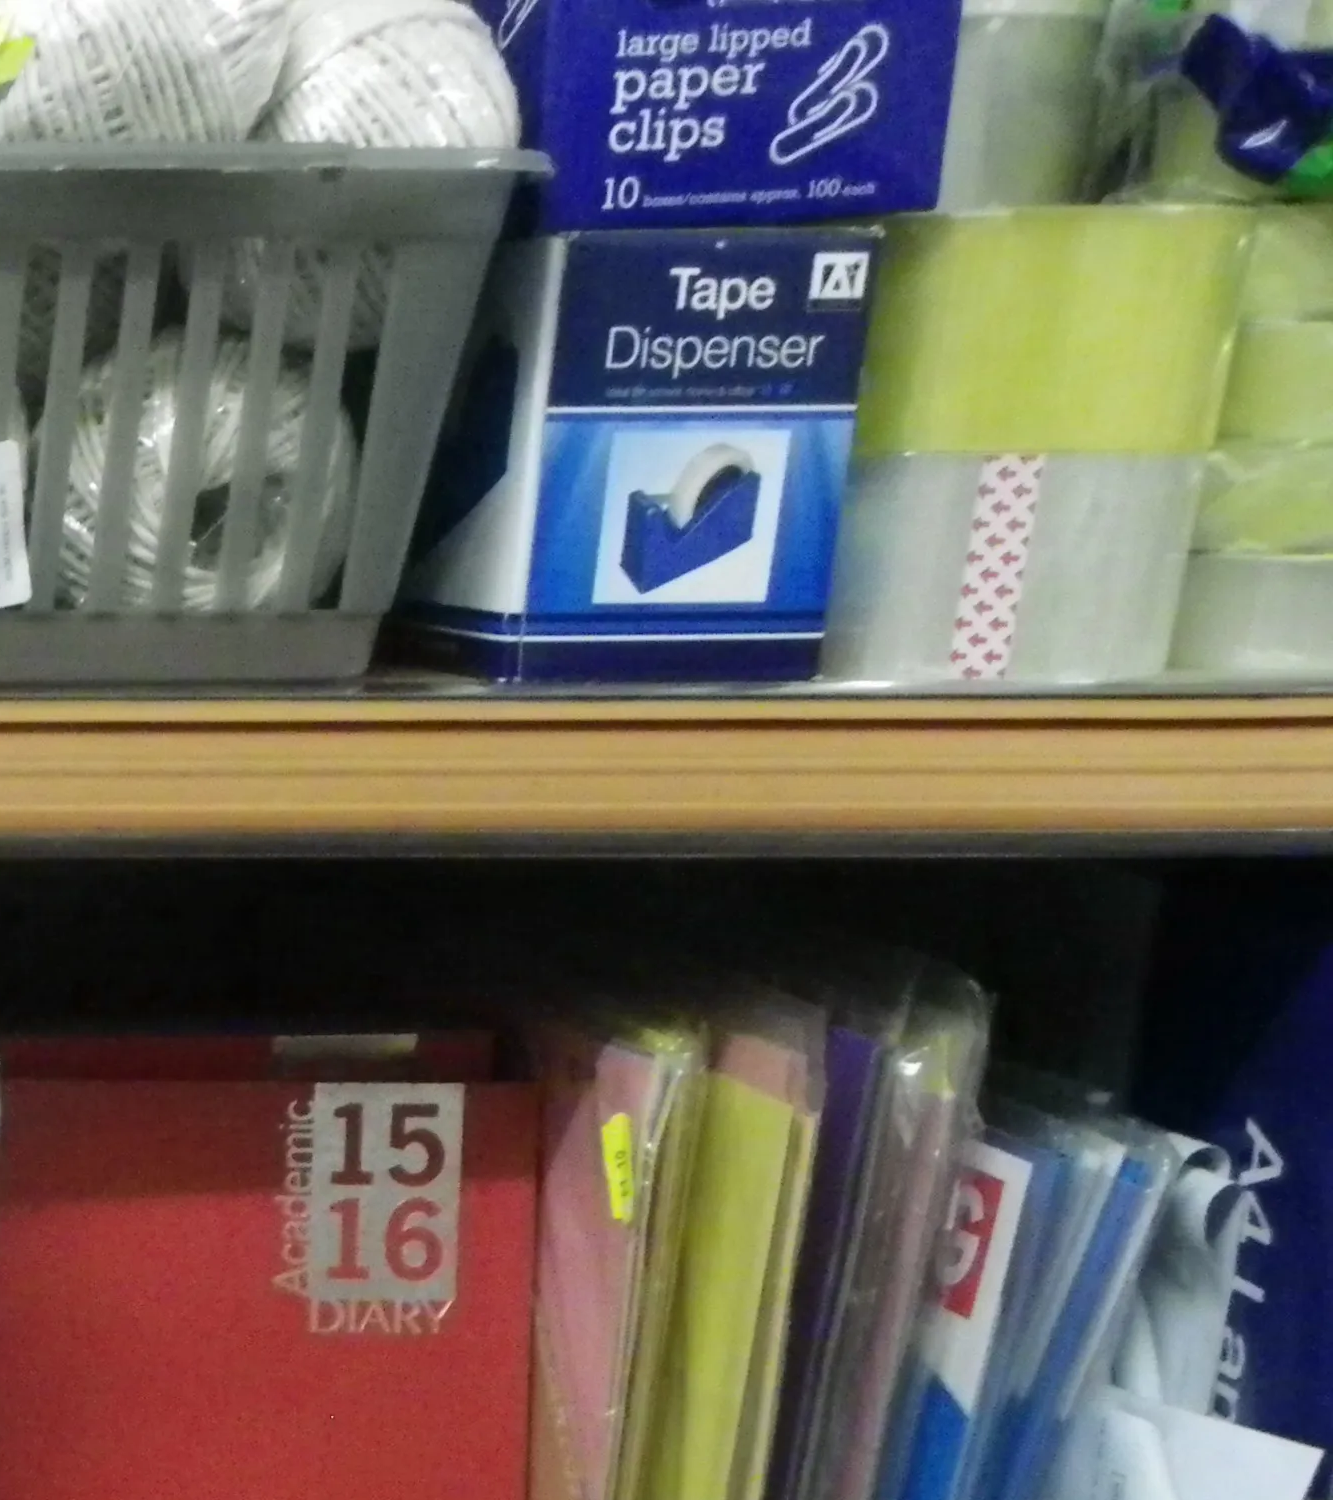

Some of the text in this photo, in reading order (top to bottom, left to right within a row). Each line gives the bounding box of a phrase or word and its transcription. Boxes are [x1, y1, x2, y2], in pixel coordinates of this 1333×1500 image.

[615, 17, 813, 63] large lipped
[609, 61, 766, 116] paper
[607, 107, 728, 163] clips
[601, 175, 641, 212] 10
[807, 177, 843, 199] 100
[669, 265, 777, 321] Tape
[604, 323, 826, 381] Dispenser
[330, 1103, 446, 1188] 15
[272, 1098, 316, 1300] Academic
[326, 1198, 444, 1284] 16
[309, 1299, 455, 1335] DIARY
